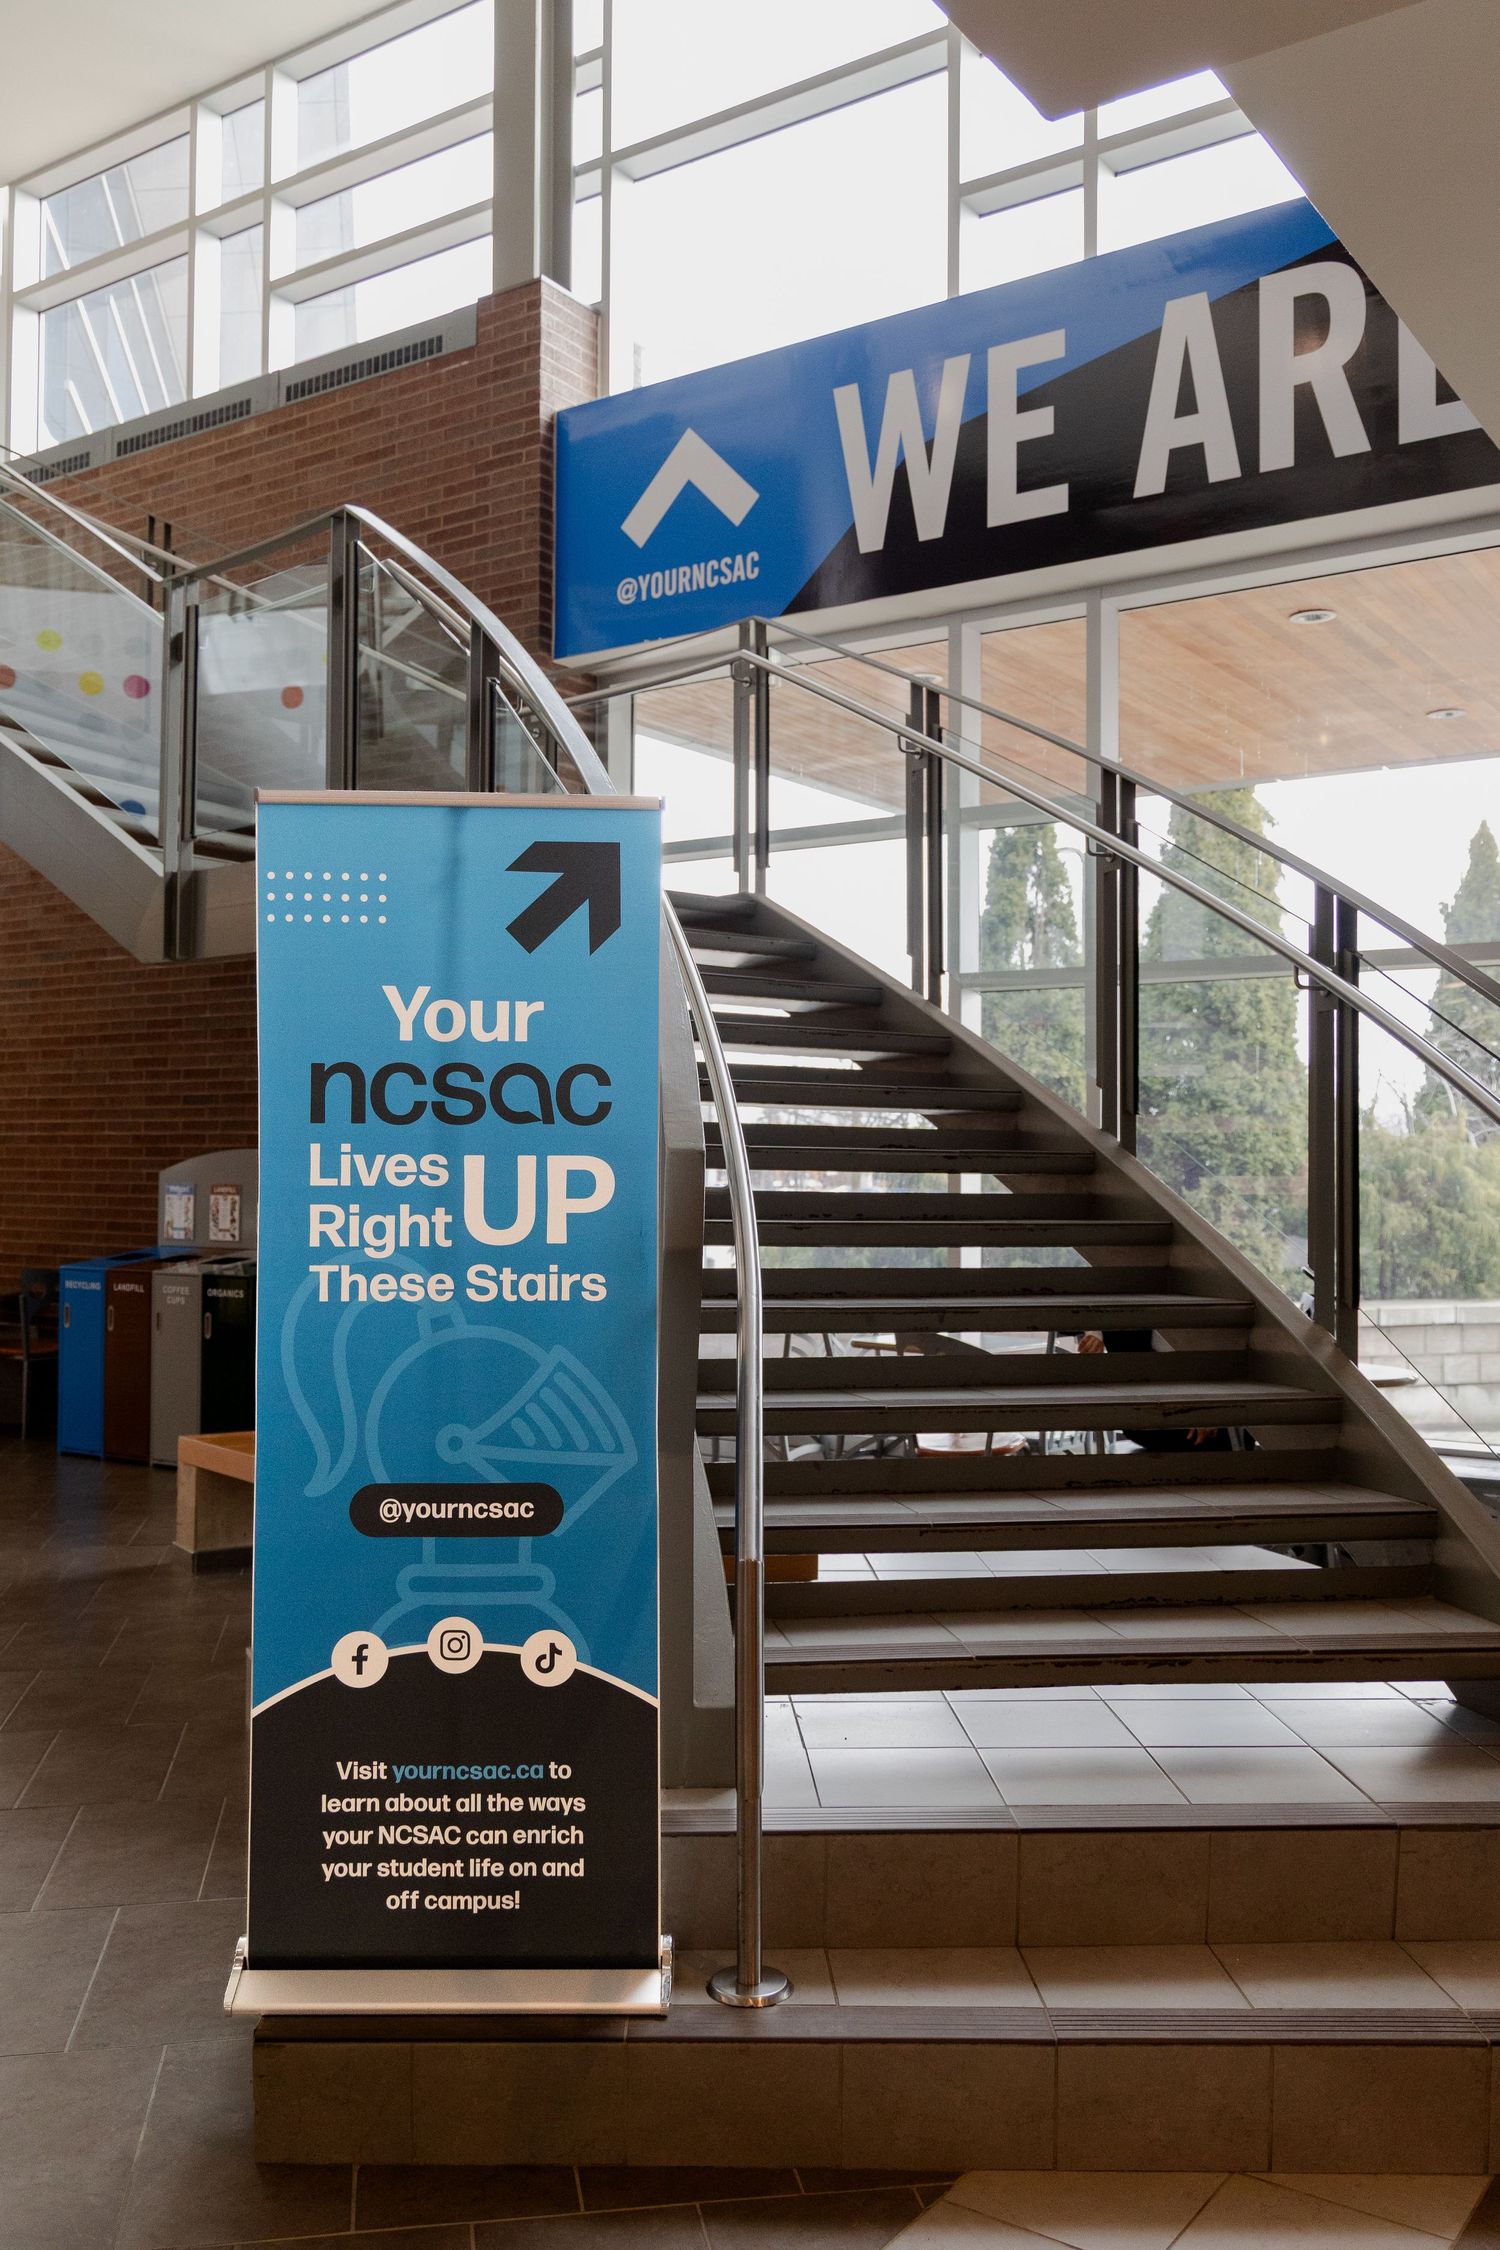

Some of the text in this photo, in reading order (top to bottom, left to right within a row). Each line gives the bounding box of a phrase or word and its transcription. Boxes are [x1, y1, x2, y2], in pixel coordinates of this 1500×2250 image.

[834, 328, 1070, 554] WE
[617, 550, 759, 605] @YOURNCSAC
[381, 984, 545, 1043] Your
[309, 1061, 613, 1127] ncsac
[309, 1143, 449, 1187] Lives
[463, 1154, 616, 1246] UP
[309, 1203, 453, 1259] Right
[113, 1283, 144, 1293] LANDFILL
[162, 1285, 190, 1296] COFFEE
[206, 1288, 244, 1299] ORGANICS
[308, 1263, 607, 1303] These Stairs
[166, 1296, 185, 1305] CUPS
[379, 1498, 535, 1524] @yourncsac
[335, 1760, 572, 1784] Visit yourncsac.ca to
[321, 1792, 586, 1816] learn about all the ways
[322, 1824, 584, 1850] your NCSAC can enrich
[321, 1857, 585, 1882] your student life on and
[385, 1890, 520, 1914] off campus!
